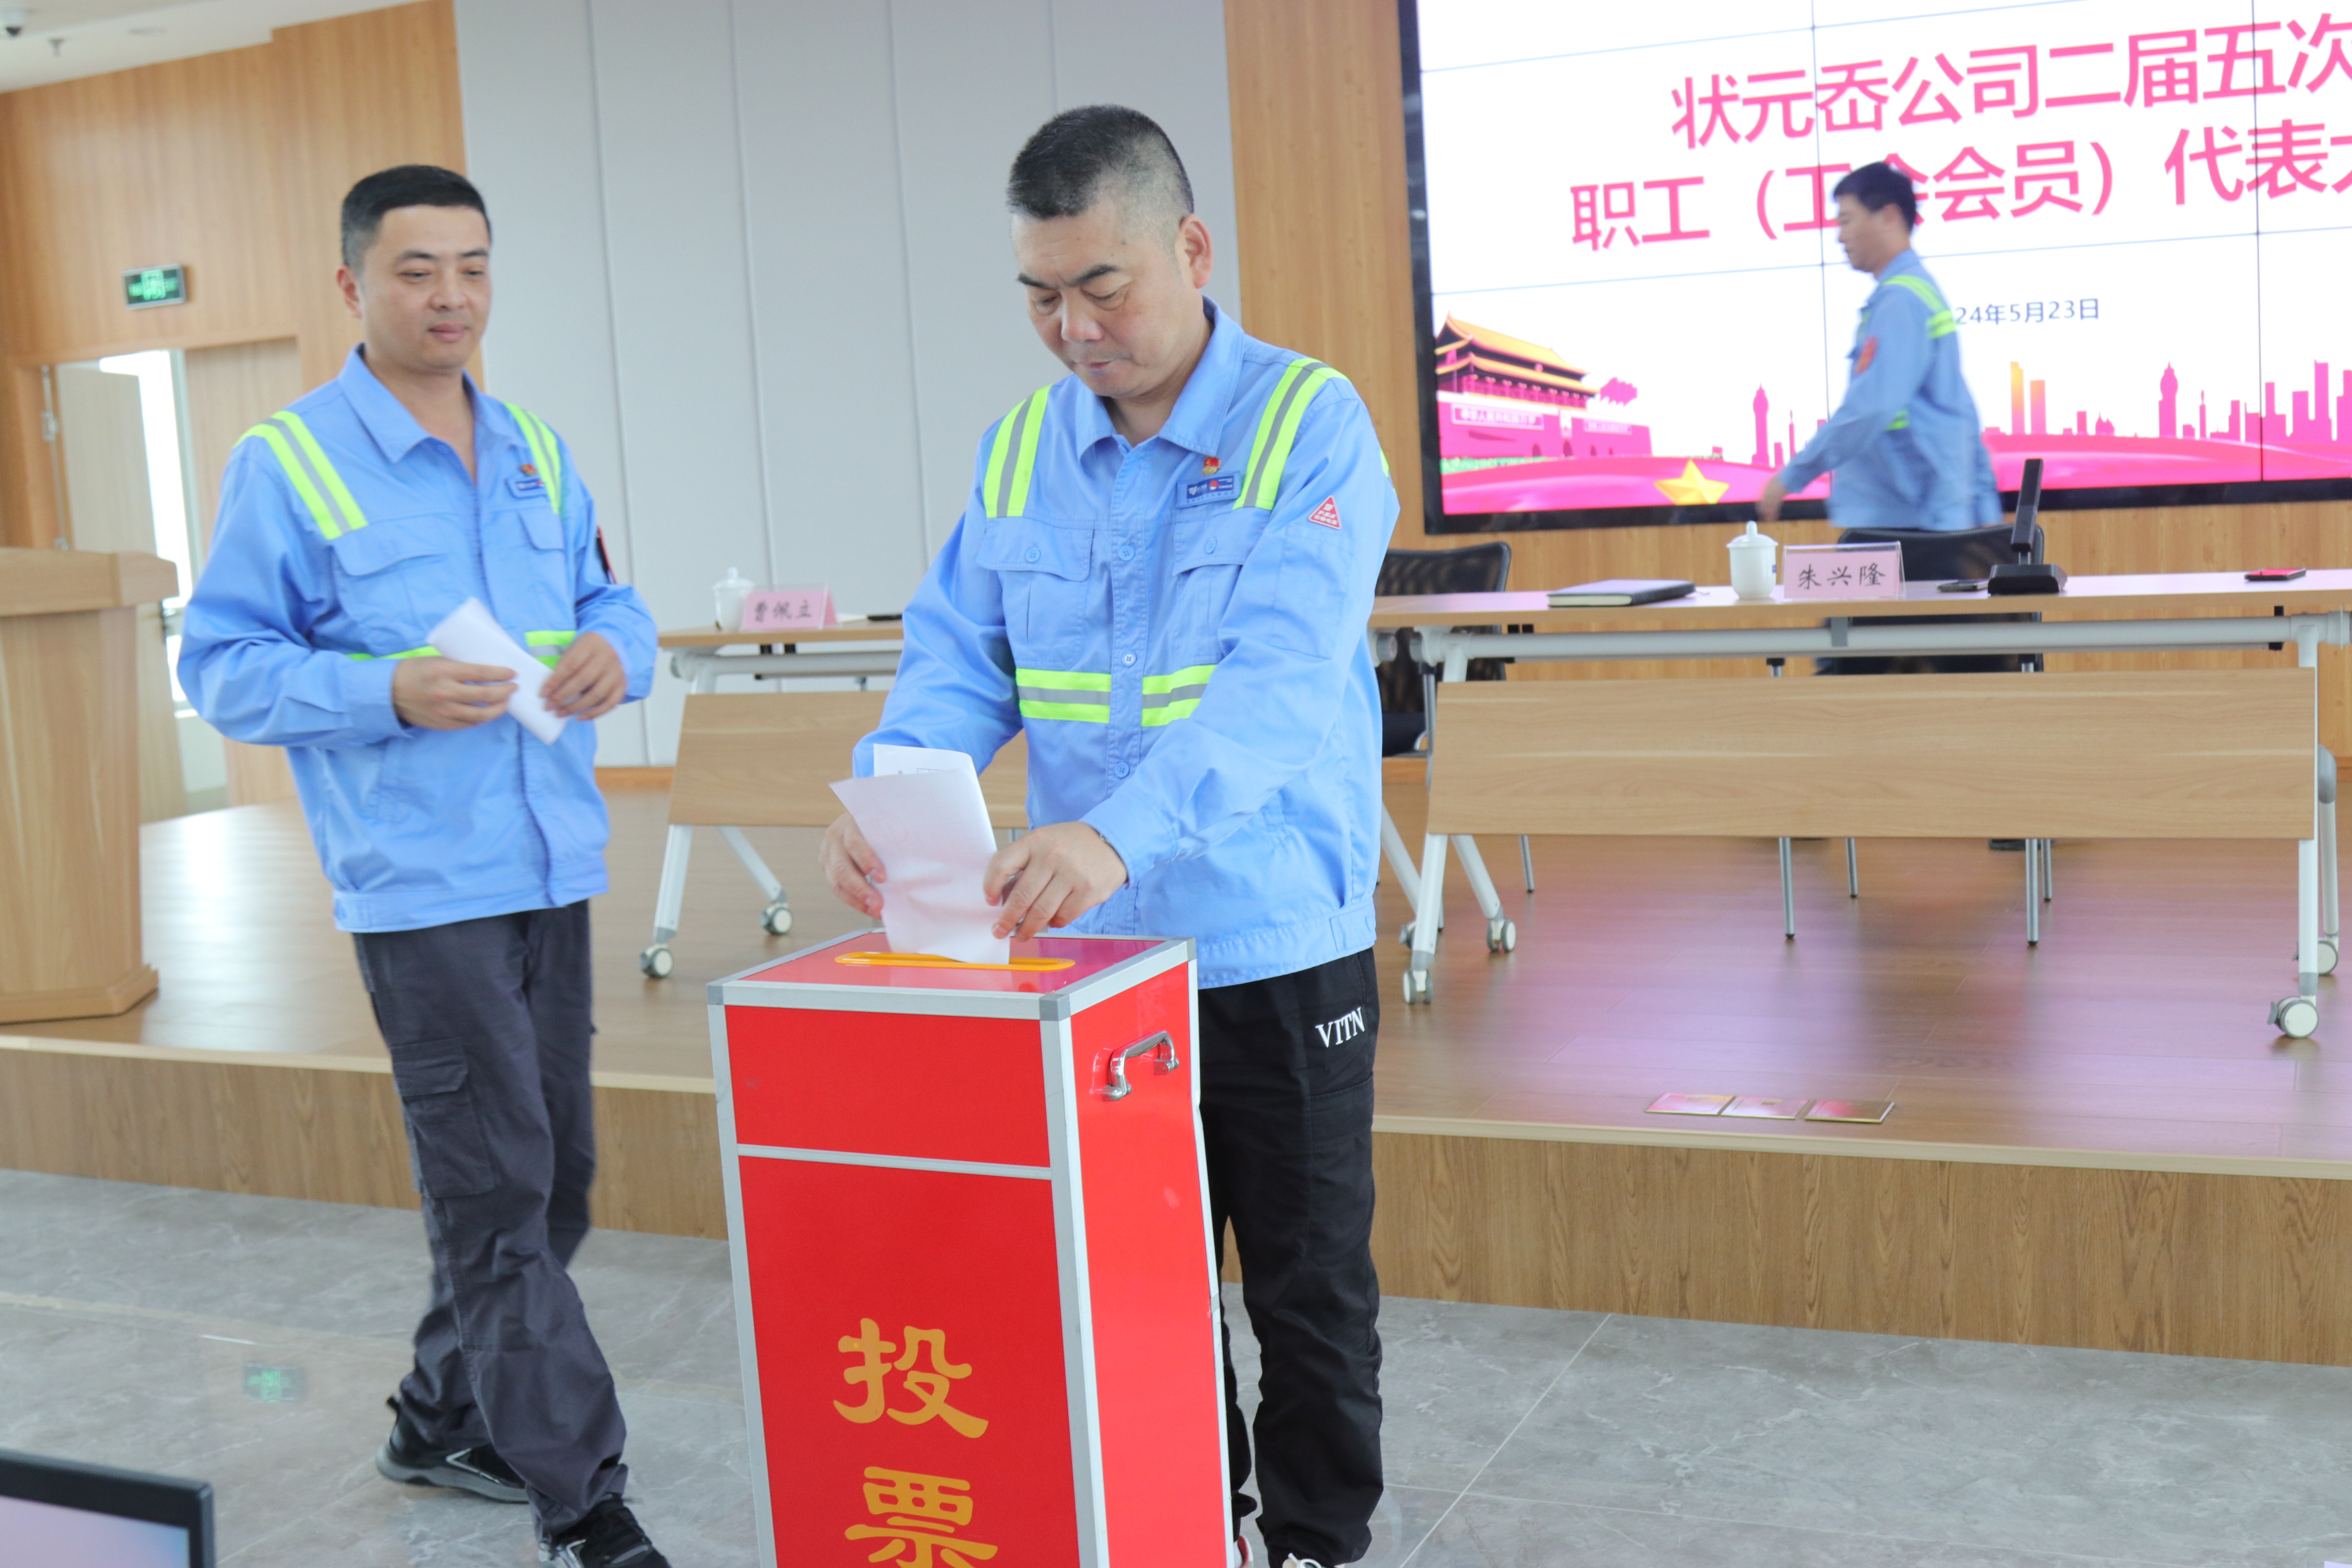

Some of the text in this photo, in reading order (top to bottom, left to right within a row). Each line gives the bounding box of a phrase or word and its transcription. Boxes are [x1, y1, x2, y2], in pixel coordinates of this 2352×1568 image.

[1671, 13, 2352, 149] 状元岙公司二届五次
[1798, 562, 1886, 590] 朱兴隆
[1315, 1007, 1365, 1048] VITN
[833, 1318, 998, 1568] 投票
